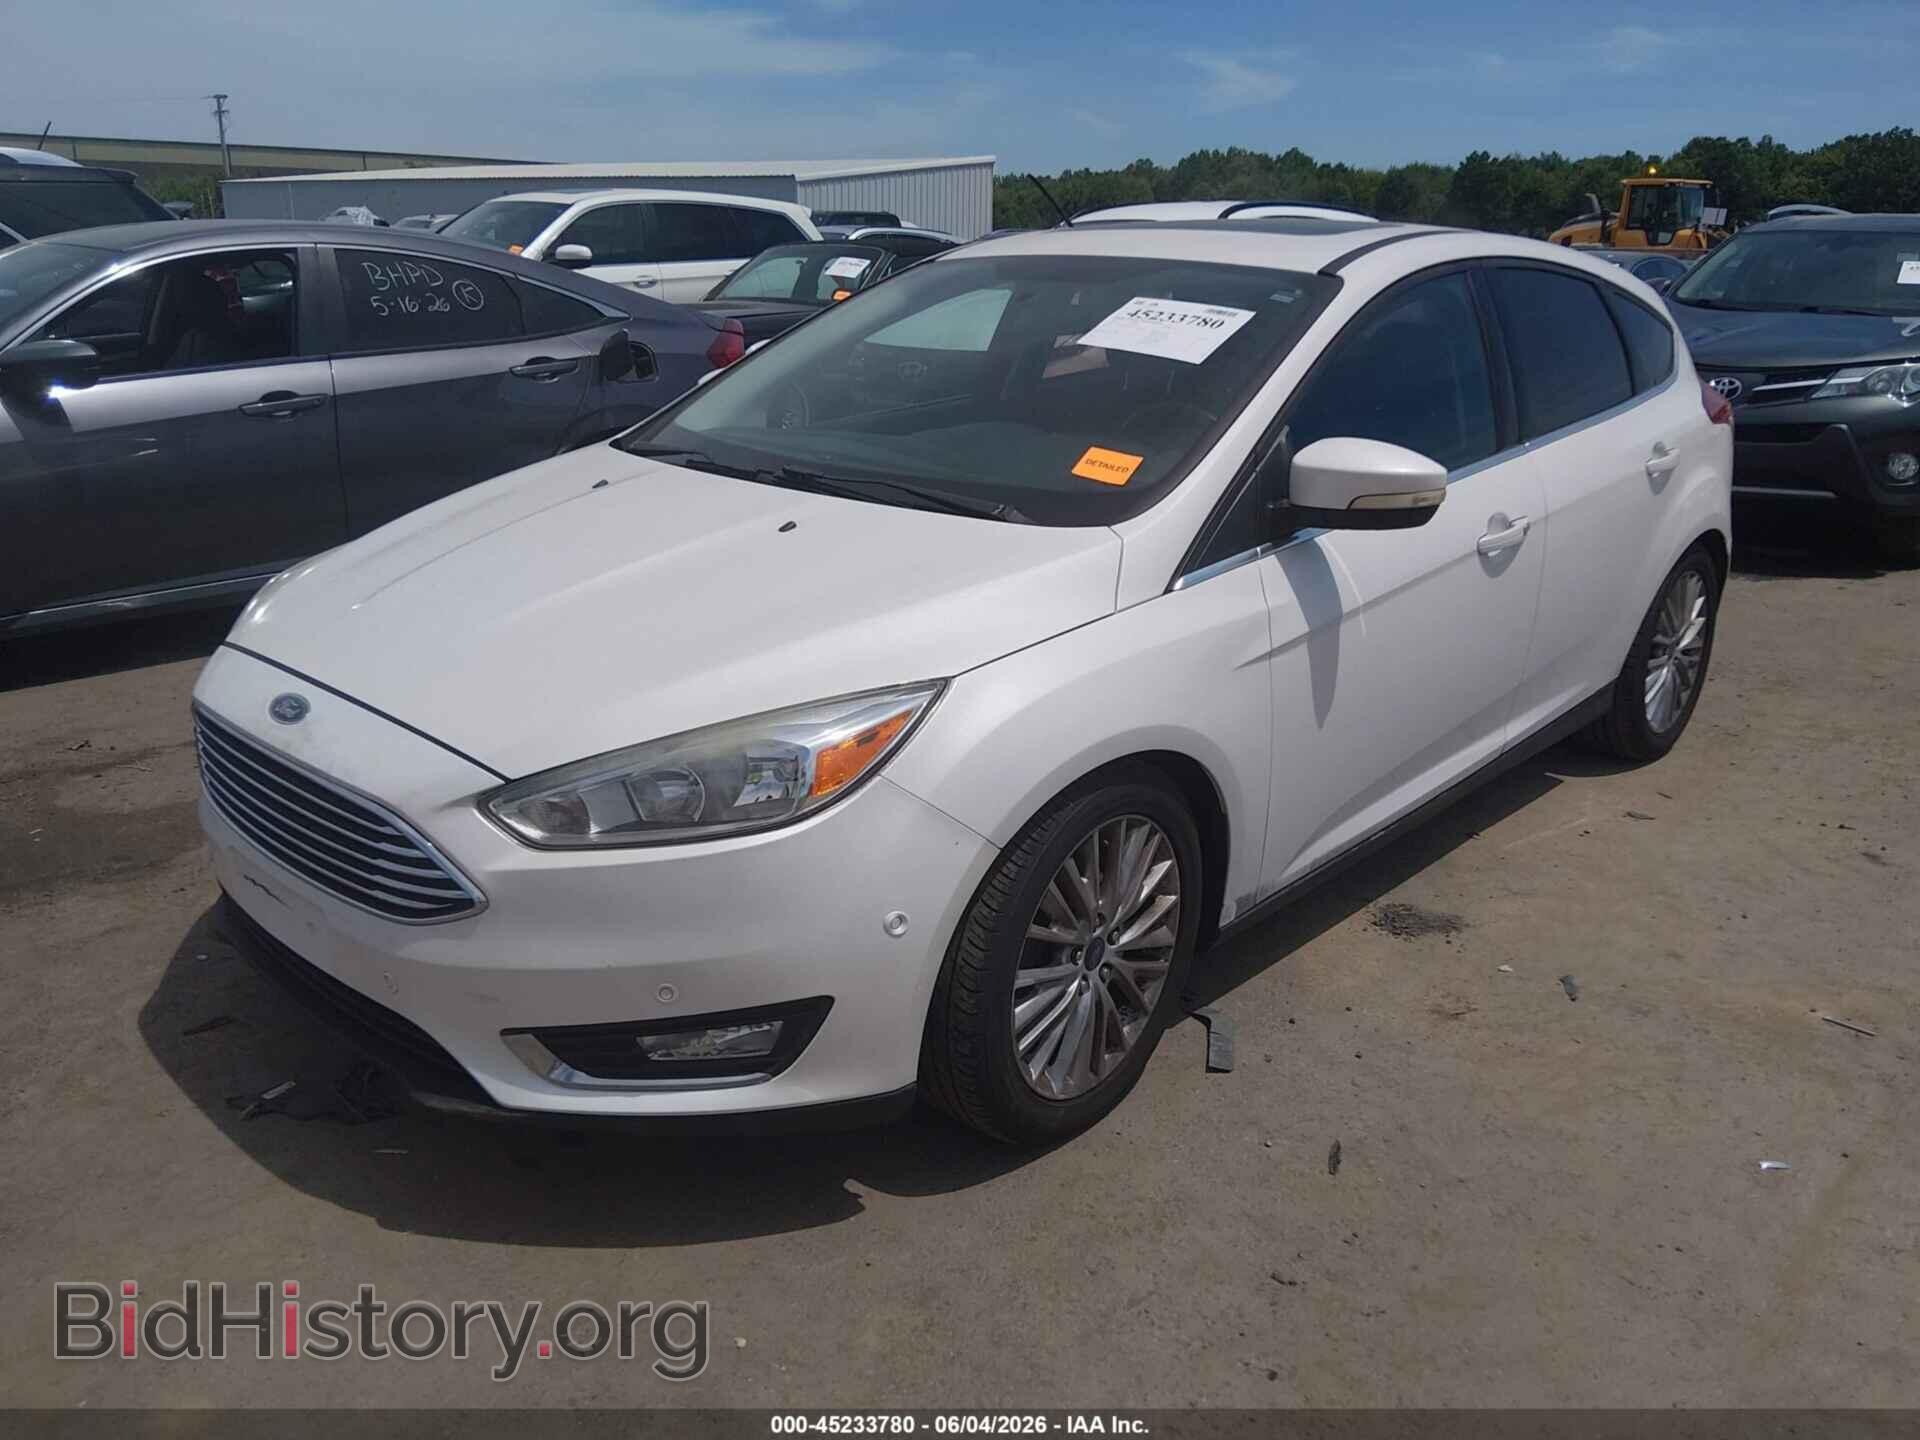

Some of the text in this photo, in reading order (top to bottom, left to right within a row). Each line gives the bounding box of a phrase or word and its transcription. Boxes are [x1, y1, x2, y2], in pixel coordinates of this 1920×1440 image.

[361, 261, 444, 291] BHPD
[1127, 309, 1226, 330] 45233780
[1085, 458, 1130, 473] DETAILED
